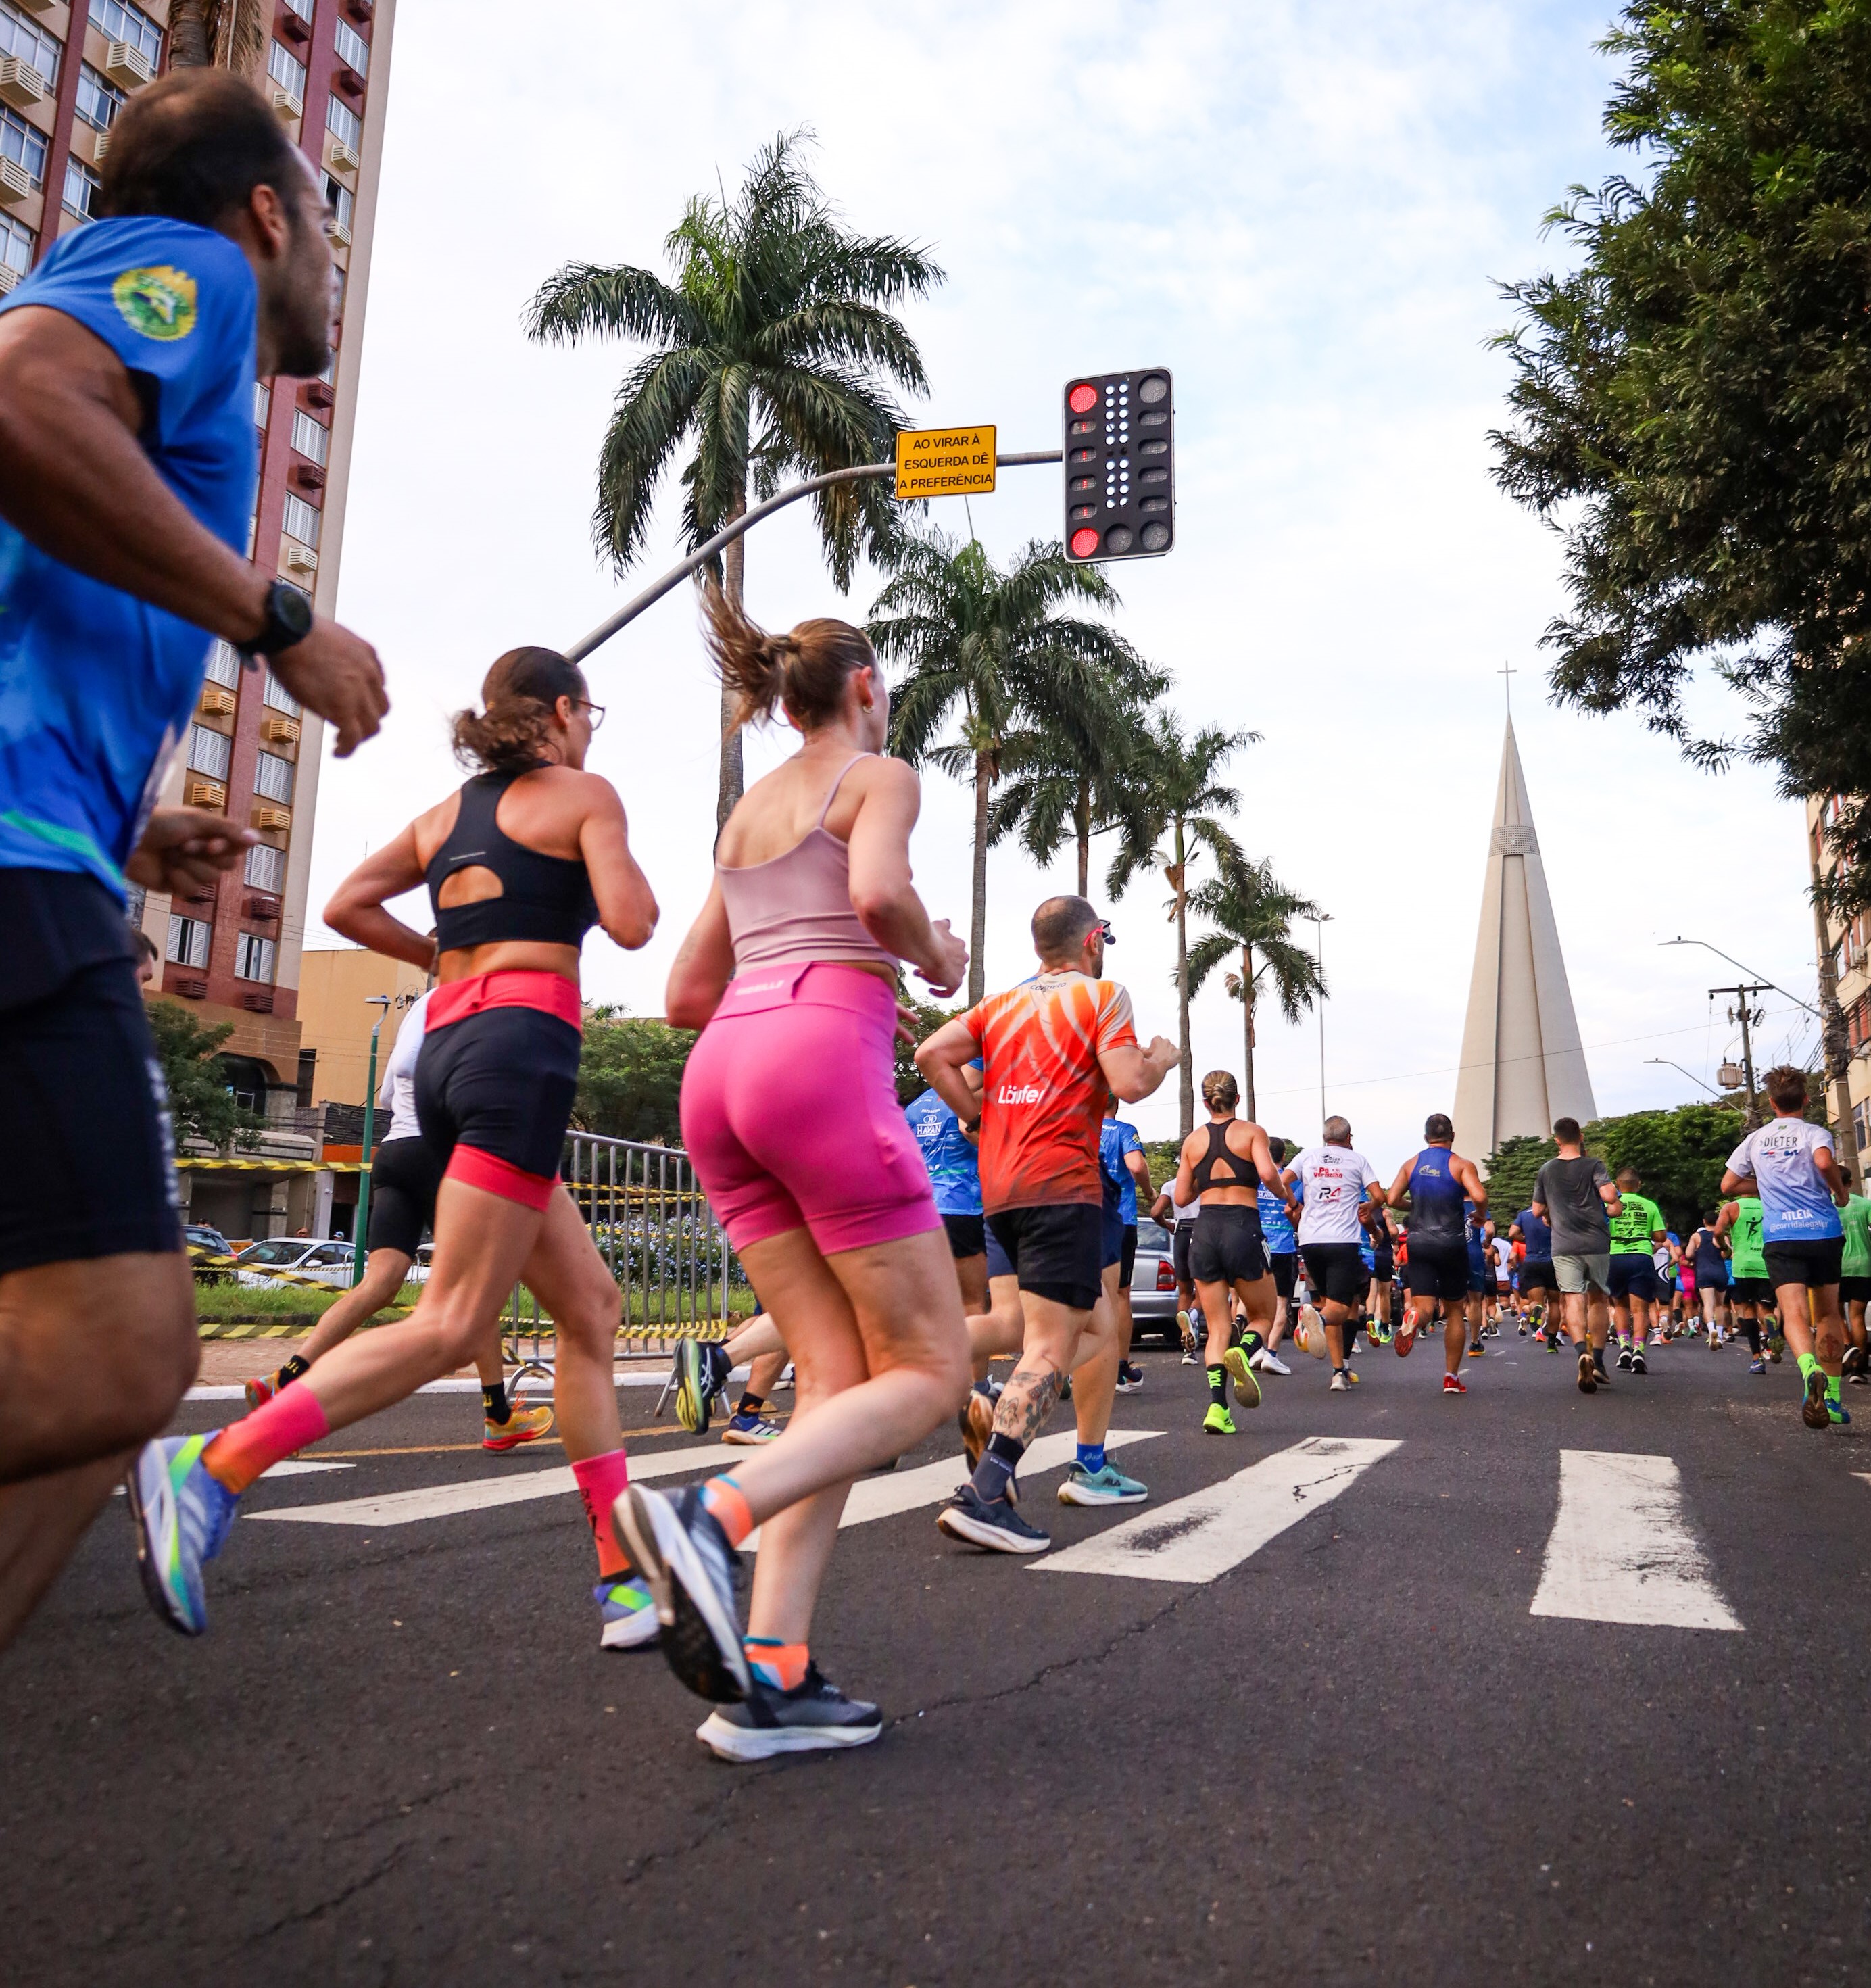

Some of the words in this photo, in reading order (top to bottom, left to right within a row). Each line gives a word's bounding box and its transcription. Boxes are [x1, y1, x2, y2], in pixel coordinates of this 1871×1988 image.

[913, 439, 930, 450] AO
[933, 436, 969, 448] VIRAR
[971, 433, 980, 445] À
[904, 456, 969, 470] ESQUERDA
[972, 452, 989, 465] DÊ
[899, 480, 908, 490] A
[910, 473, 992, 489] PREFERÊNCIA
[998, 1084, 1046, 1105] Läufer
[917, 1123, 942, 1136] HAVAN
[1764, 1136, 1797, 1147] DIETER
[1781, 1209, 1813, 1221] ATLETA
